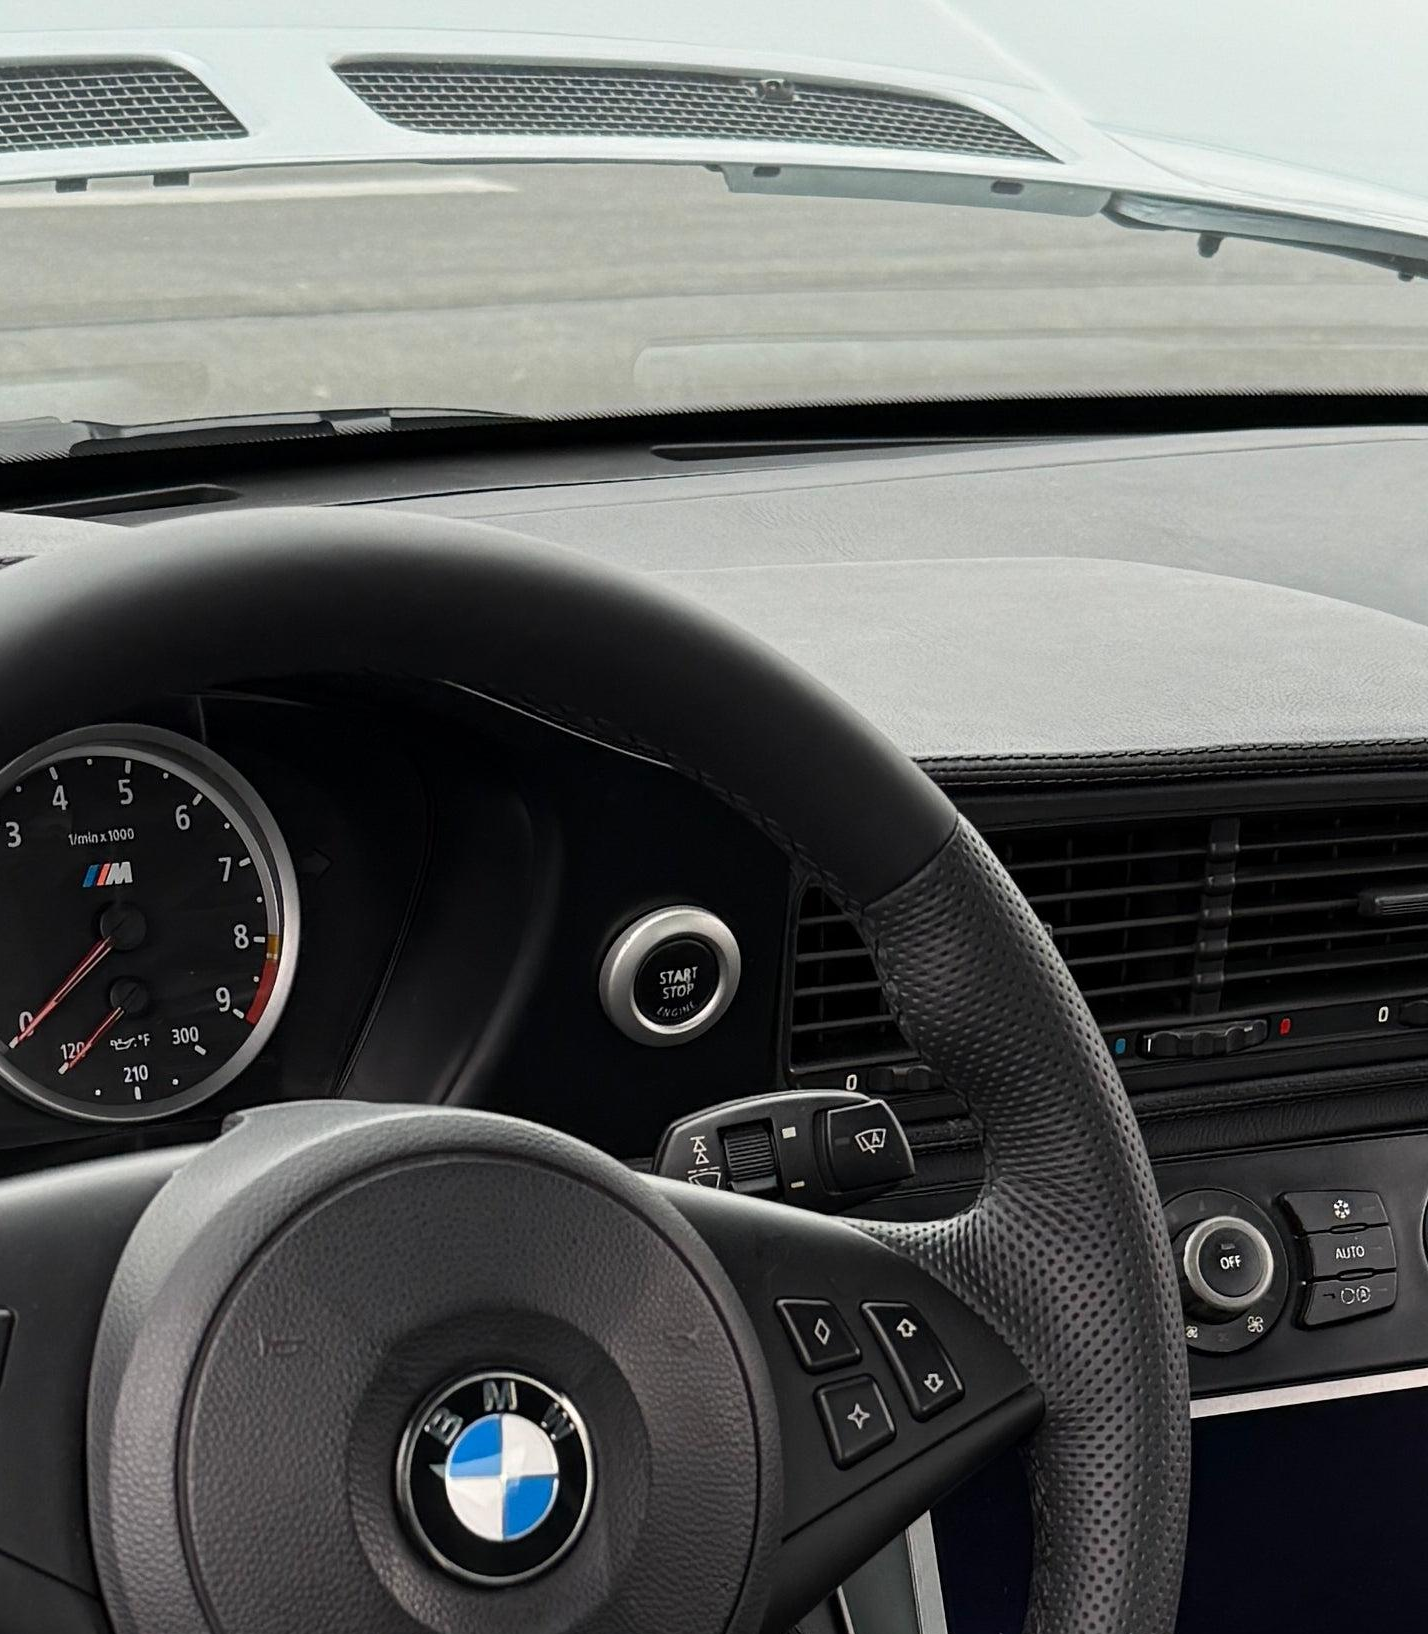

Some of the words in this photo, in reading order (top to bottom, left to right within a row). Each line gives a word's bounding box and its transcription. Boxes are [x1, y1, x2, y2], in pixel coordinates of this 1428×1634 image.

[52, 785, 68, 811] 4
[118, 779, 133, 805] 5
[175, 805, 190, 830] 6
[6, 822, 22, 848] 3
[108, 828, 134, 842] 1000
[218, 857, 232, 882] 7
[234, 924, 250, 950] 8
[660, 966, 698, 984] START
[215, 987, 232, 1012] 9
[663, 984, 694, 999] STOP
[19, 1011, 34, 1036] 0
[171, 1026, 199, 1045] 300
[60, 1042, 86, 1060] 120
[124, 1064, 148, 1083] 210
[1220, 1255, 1241, 1269] OFF
[1336, 1246, 1364, 1259] AUTO
[424, 1380, 574, 1445] BMW
